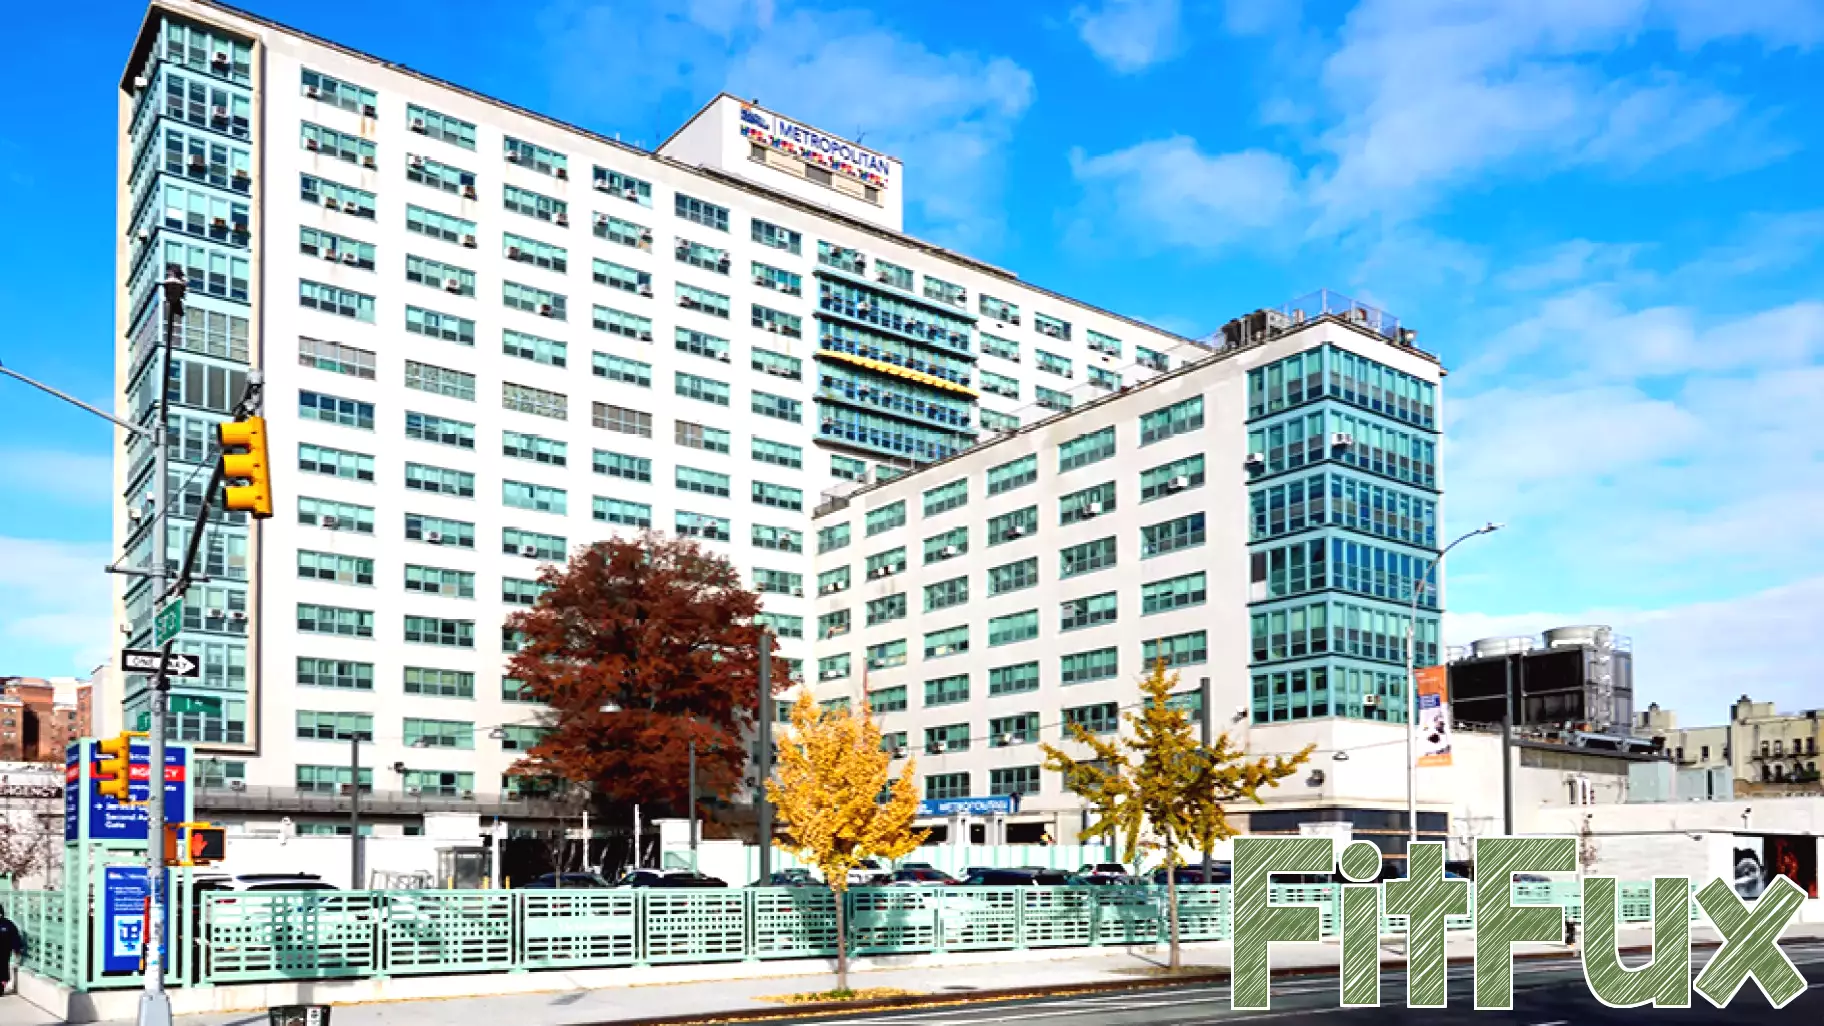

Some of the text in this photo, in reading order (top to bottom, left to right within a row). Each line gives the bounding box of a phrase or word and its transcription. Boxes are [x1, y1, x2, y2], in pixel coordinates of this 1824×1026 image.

[780, 121, 889, 175] METROPOLITAN
[132, 655, 154, 666] ONE
[939, 800, 1008, 812] METROPOLITAN
[105, 821, 126, 829] Gate
